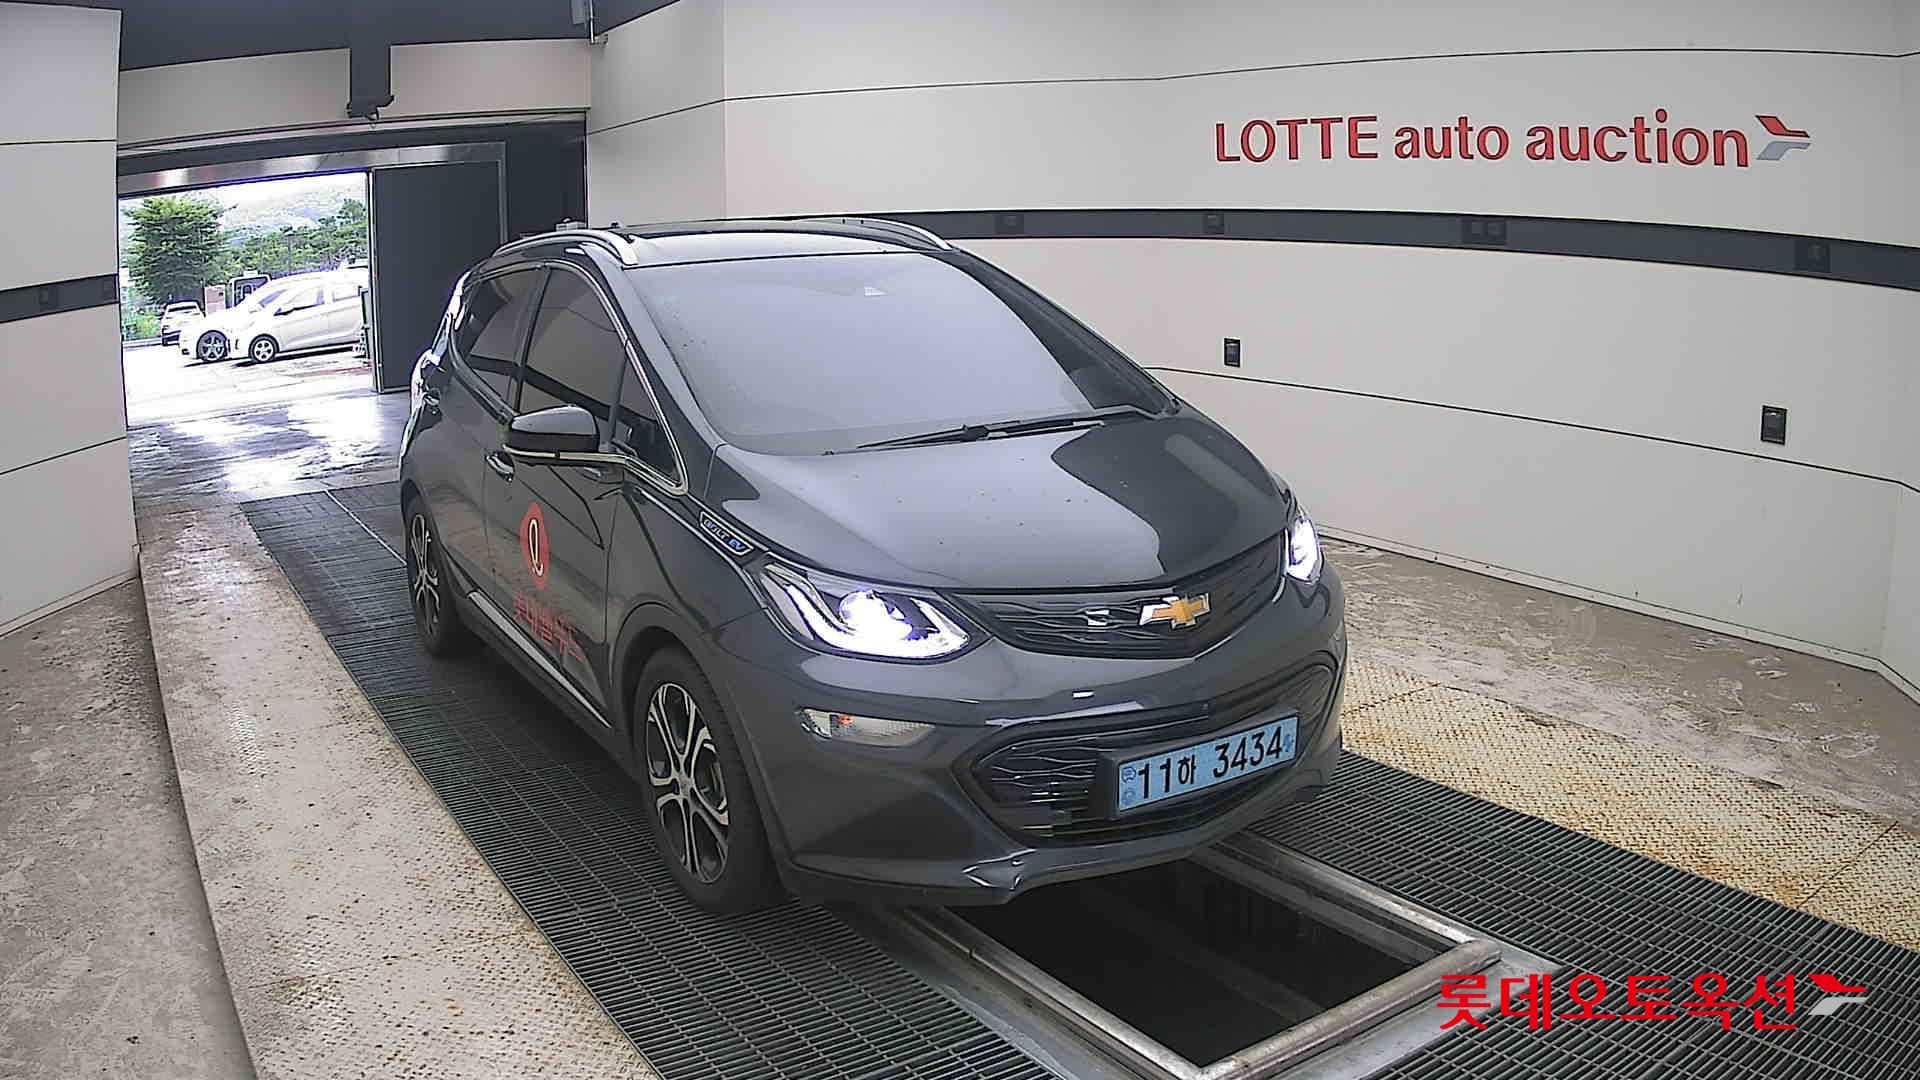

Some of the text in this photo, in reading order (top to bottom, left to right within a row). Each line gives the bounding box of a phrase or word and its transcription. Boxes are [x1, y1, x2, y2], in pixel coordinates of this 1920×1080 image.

[1215, 108, 1750, 168] LOTTE auto auction
[1137, 725, 1283, 800] 11하 3434
